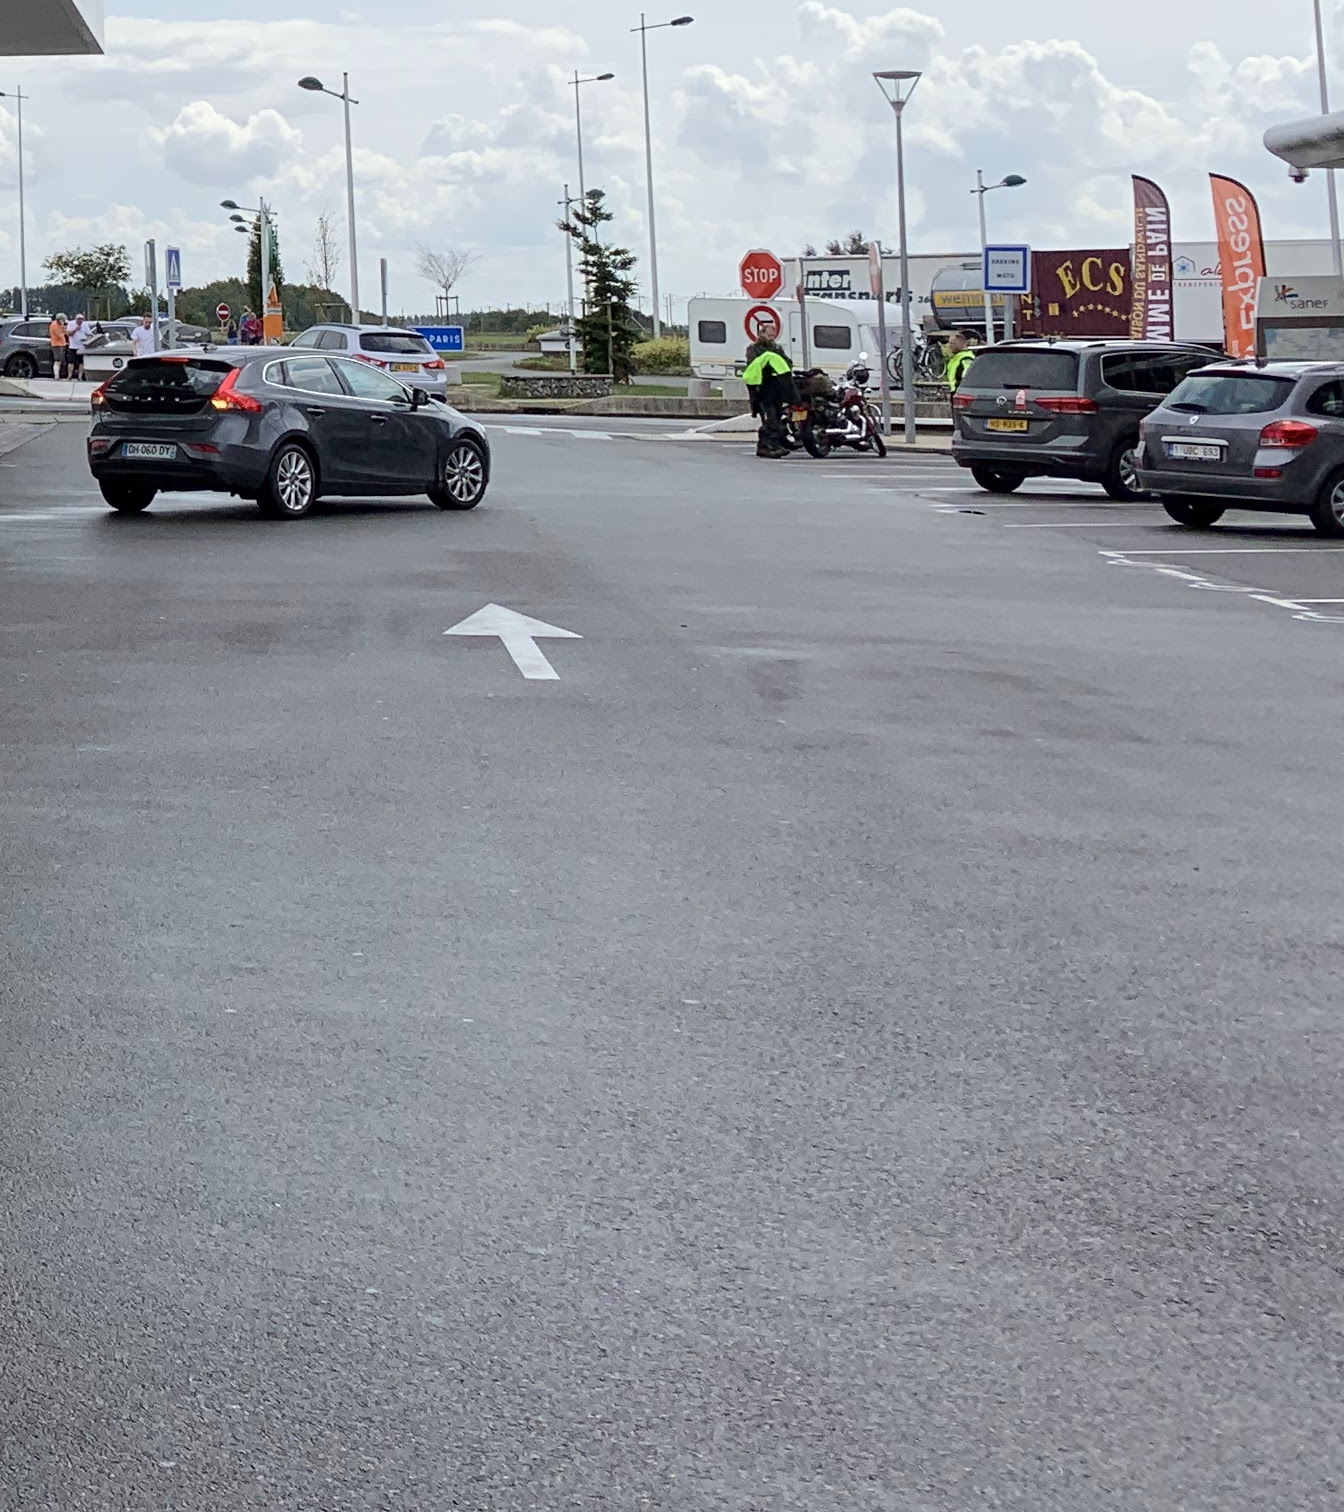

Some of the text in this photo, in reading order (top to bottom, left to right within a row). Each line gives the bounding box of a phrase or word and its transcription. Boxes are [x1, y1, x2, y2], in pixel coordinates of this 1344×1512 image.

[744, 266, 779, 284] STOP
[1055, 256, 1126, 300] ECS
[429, 334, 461, 344] PARIS
